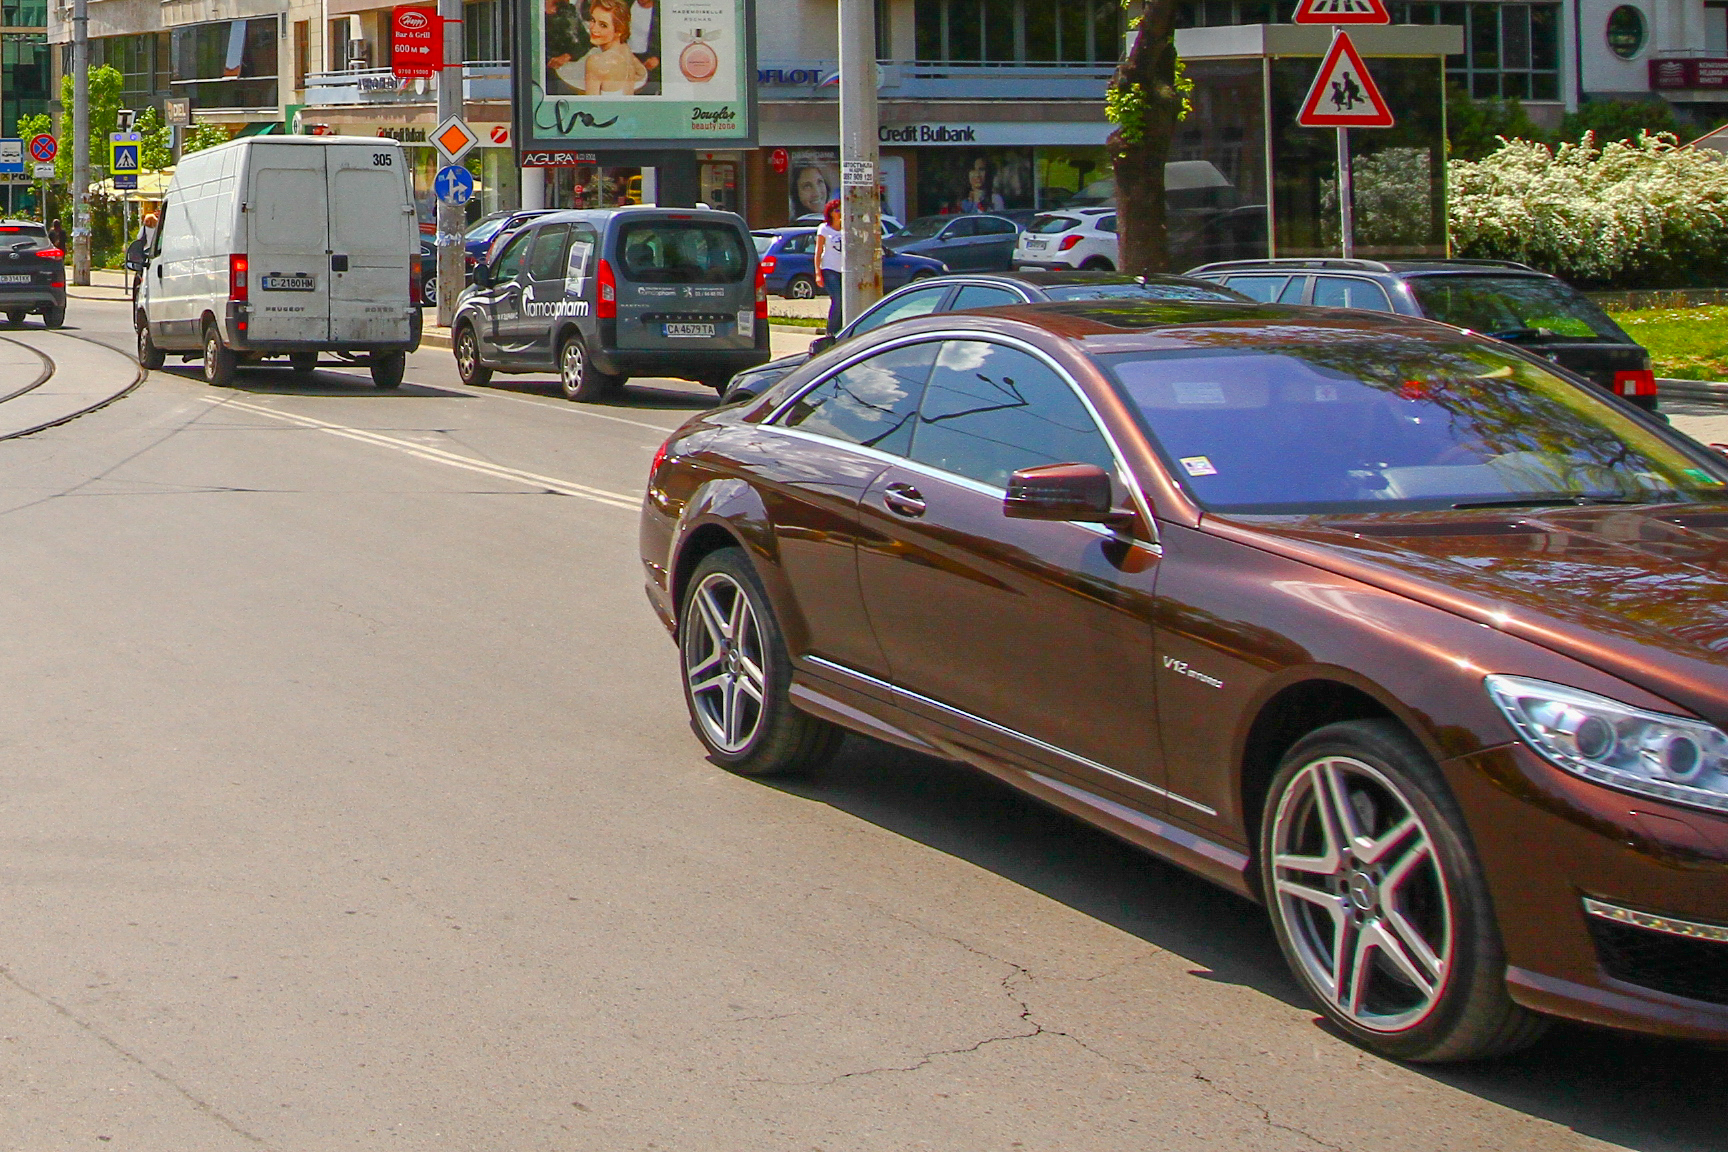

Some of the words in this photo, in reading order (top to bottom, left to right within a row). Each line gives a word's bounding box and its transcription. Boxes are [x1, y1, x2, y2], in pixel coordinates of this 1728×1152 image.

[401, 15, 425, 27] Happy
[394, 44, 410, 53] 600
[691, 105, 736, 123] Douglas
[691, 122, 717, 131] beauty
[921, 126, 976, 143] Bulbank
[373, 153, 392, 167] 305
[523, 153, 575, 165] AGURA
[271, 278, 277, 287] C
[280, 279, 301, 288] 2180
[301, 279, 313, 288] HM
[667, 325, 680, 334] CA
[680, 325, 700, 334] 4679
[702, 325, 714, 334] TA
[1163, 655, 1189, 674] V12
